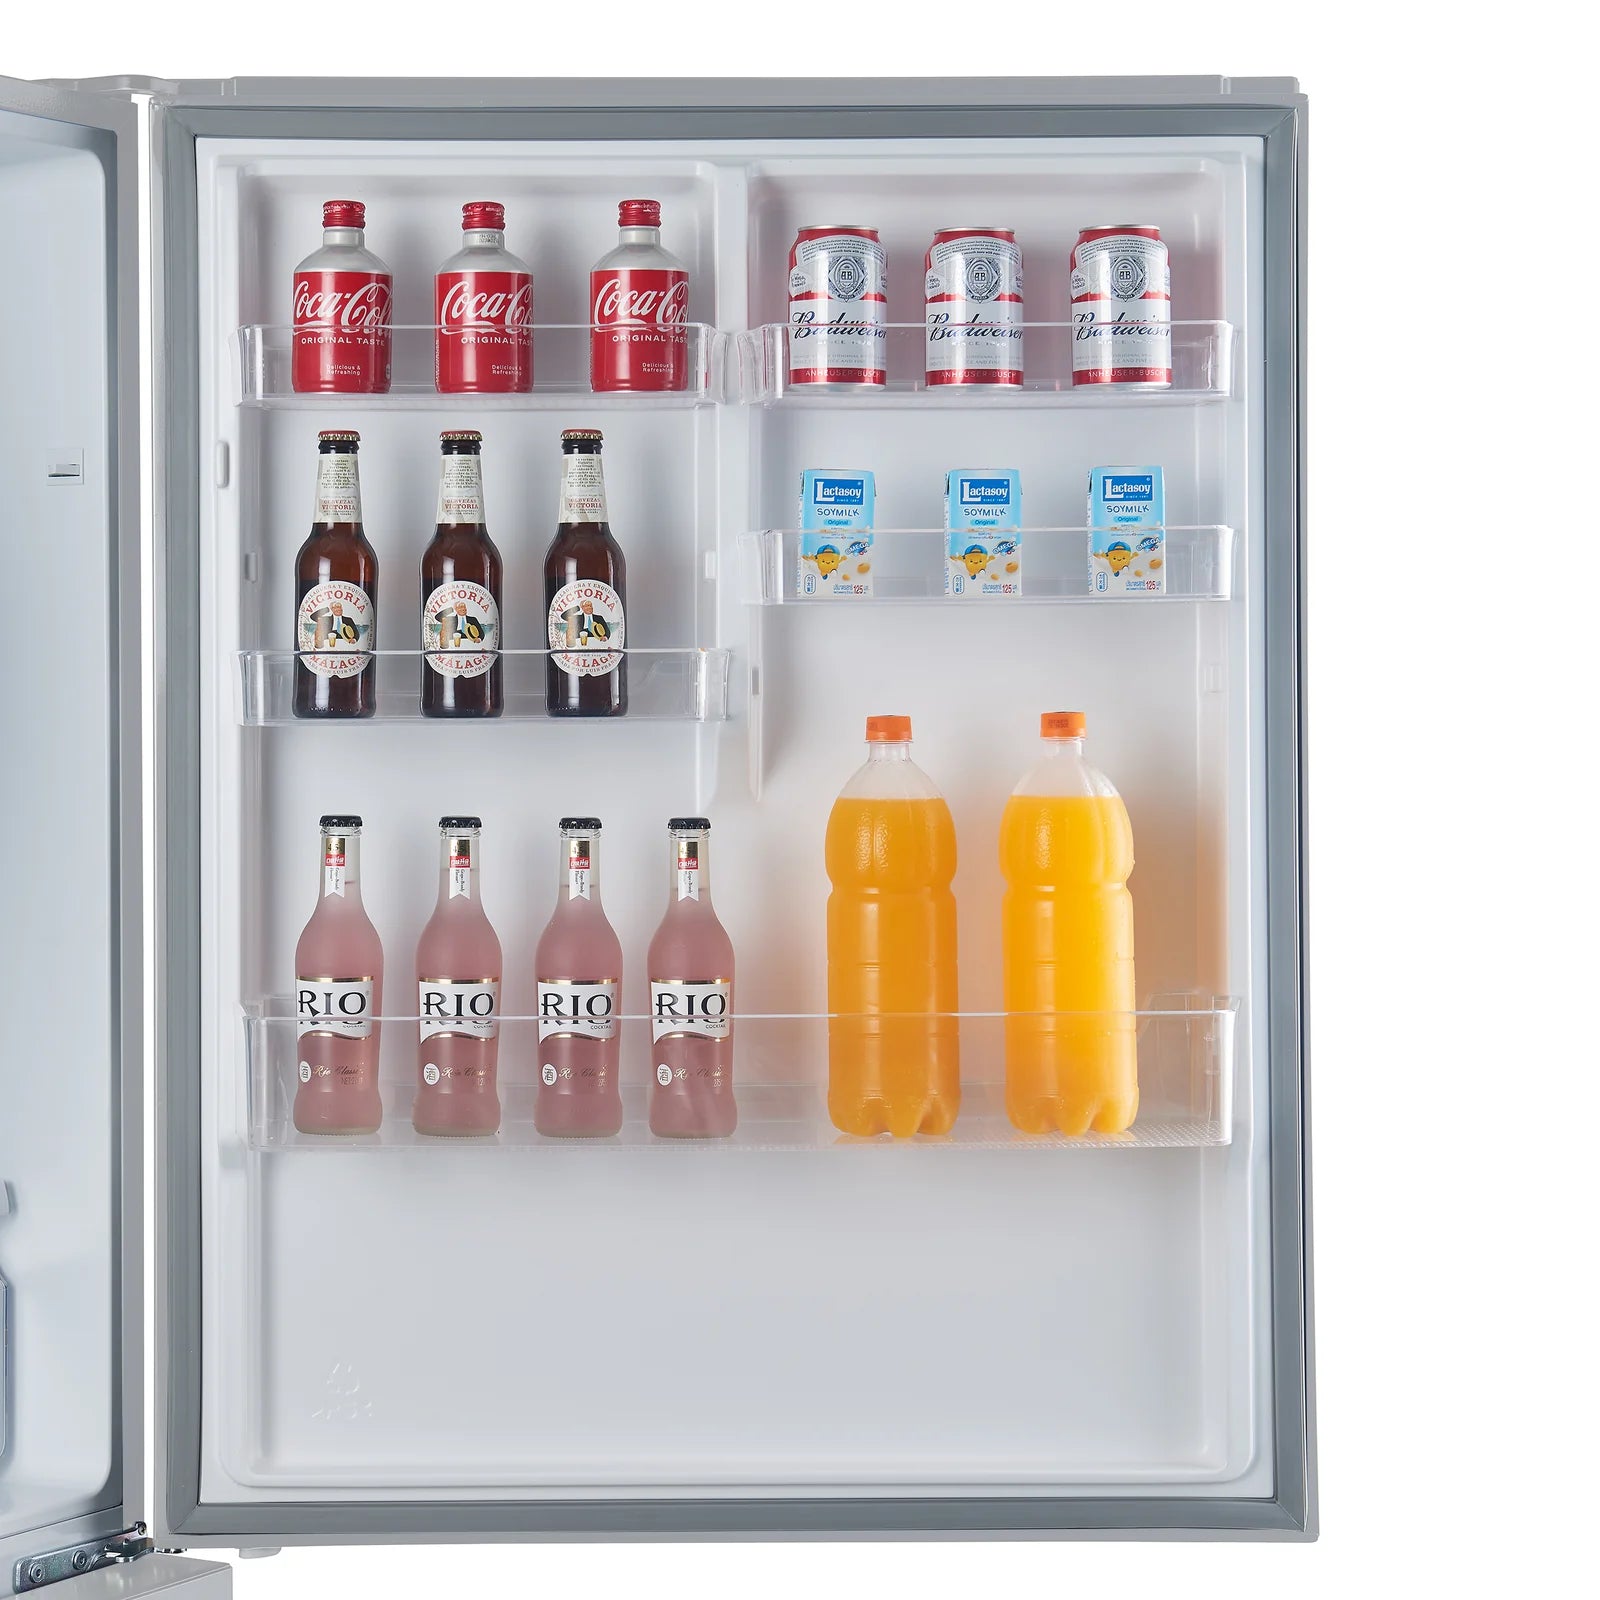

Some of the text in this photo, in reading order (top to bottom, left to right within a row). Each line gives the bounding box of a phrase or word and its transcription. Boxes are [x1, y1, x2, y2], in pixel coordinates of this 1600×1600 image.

[792, 311, 887, 339] Budweiser
[927, 313, 1024, 341] Budweiser
[1073, 312, 1170, 341] Budweiser
[301, 337, 385, 346] ORIGINAL TASTE
[612, 335, 666, 343] ORIGINAL
[805, 369, 880, 377] ANHEUSER-BUSCH
[1088, 369, 1164, 377] ANHEUSER-BUSCH
[816, 482, 862, 501] Lactasoy
[962, 482, 1008, 501] Lactasoy
[1104, 479, 1151, 499] Lactasoy
[816, 507, 860, 517] SOYMILK
[963, 507, 1007, 517] SOYMILK
[1106, 504, 1150, 513] SOYMILK
[853, 584, 864, 594] 125
[1002, 584, 1012, 593] 125
[1145, 580, 1156, 591] 125
[306, 590, 367, 614] VICTORIA
[430, 589, 490, 614] VICTORIA
[556, 588, 616, 613] VICTORIA
[310, 651, 363, 670] MÁLAGA
[435, 651, 488, 670] MÁLAGA
[562, 650, 615, 668] MÁLAGA
[298, 990, 367, 1025] RIO
[423, 992, 494, 1025] RIO
[541, 992, 612, 1025] RIO
[655, 992, 726, 1025] RIO
